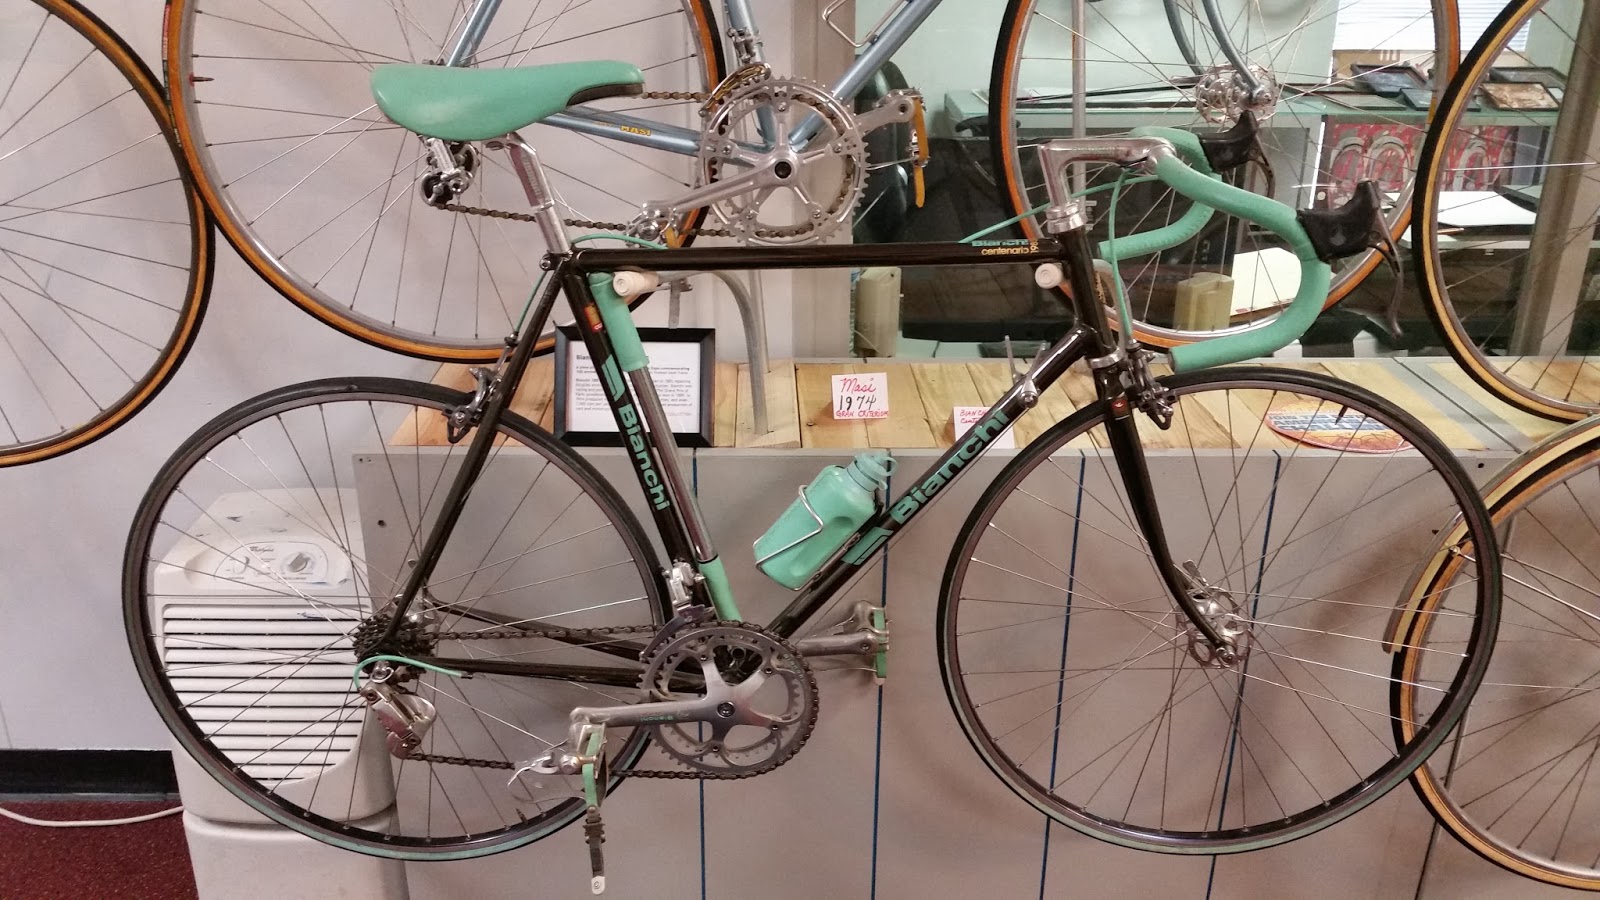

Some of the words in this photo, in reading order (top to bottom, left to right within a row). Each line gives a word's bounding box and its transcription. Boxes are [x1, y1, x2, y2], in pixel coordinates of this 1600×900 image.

[621, 125, 652, 136] MASI
[981, 246, 1029, 256] centenario
[840, 378, 877, 394] Masi
[840, 395, 877, 411] 1974
[836, 410, 855, 418] GRAN
[618, 402, 670, 511] Bianchi
[890, 411, 1010, 524] Bianchi
